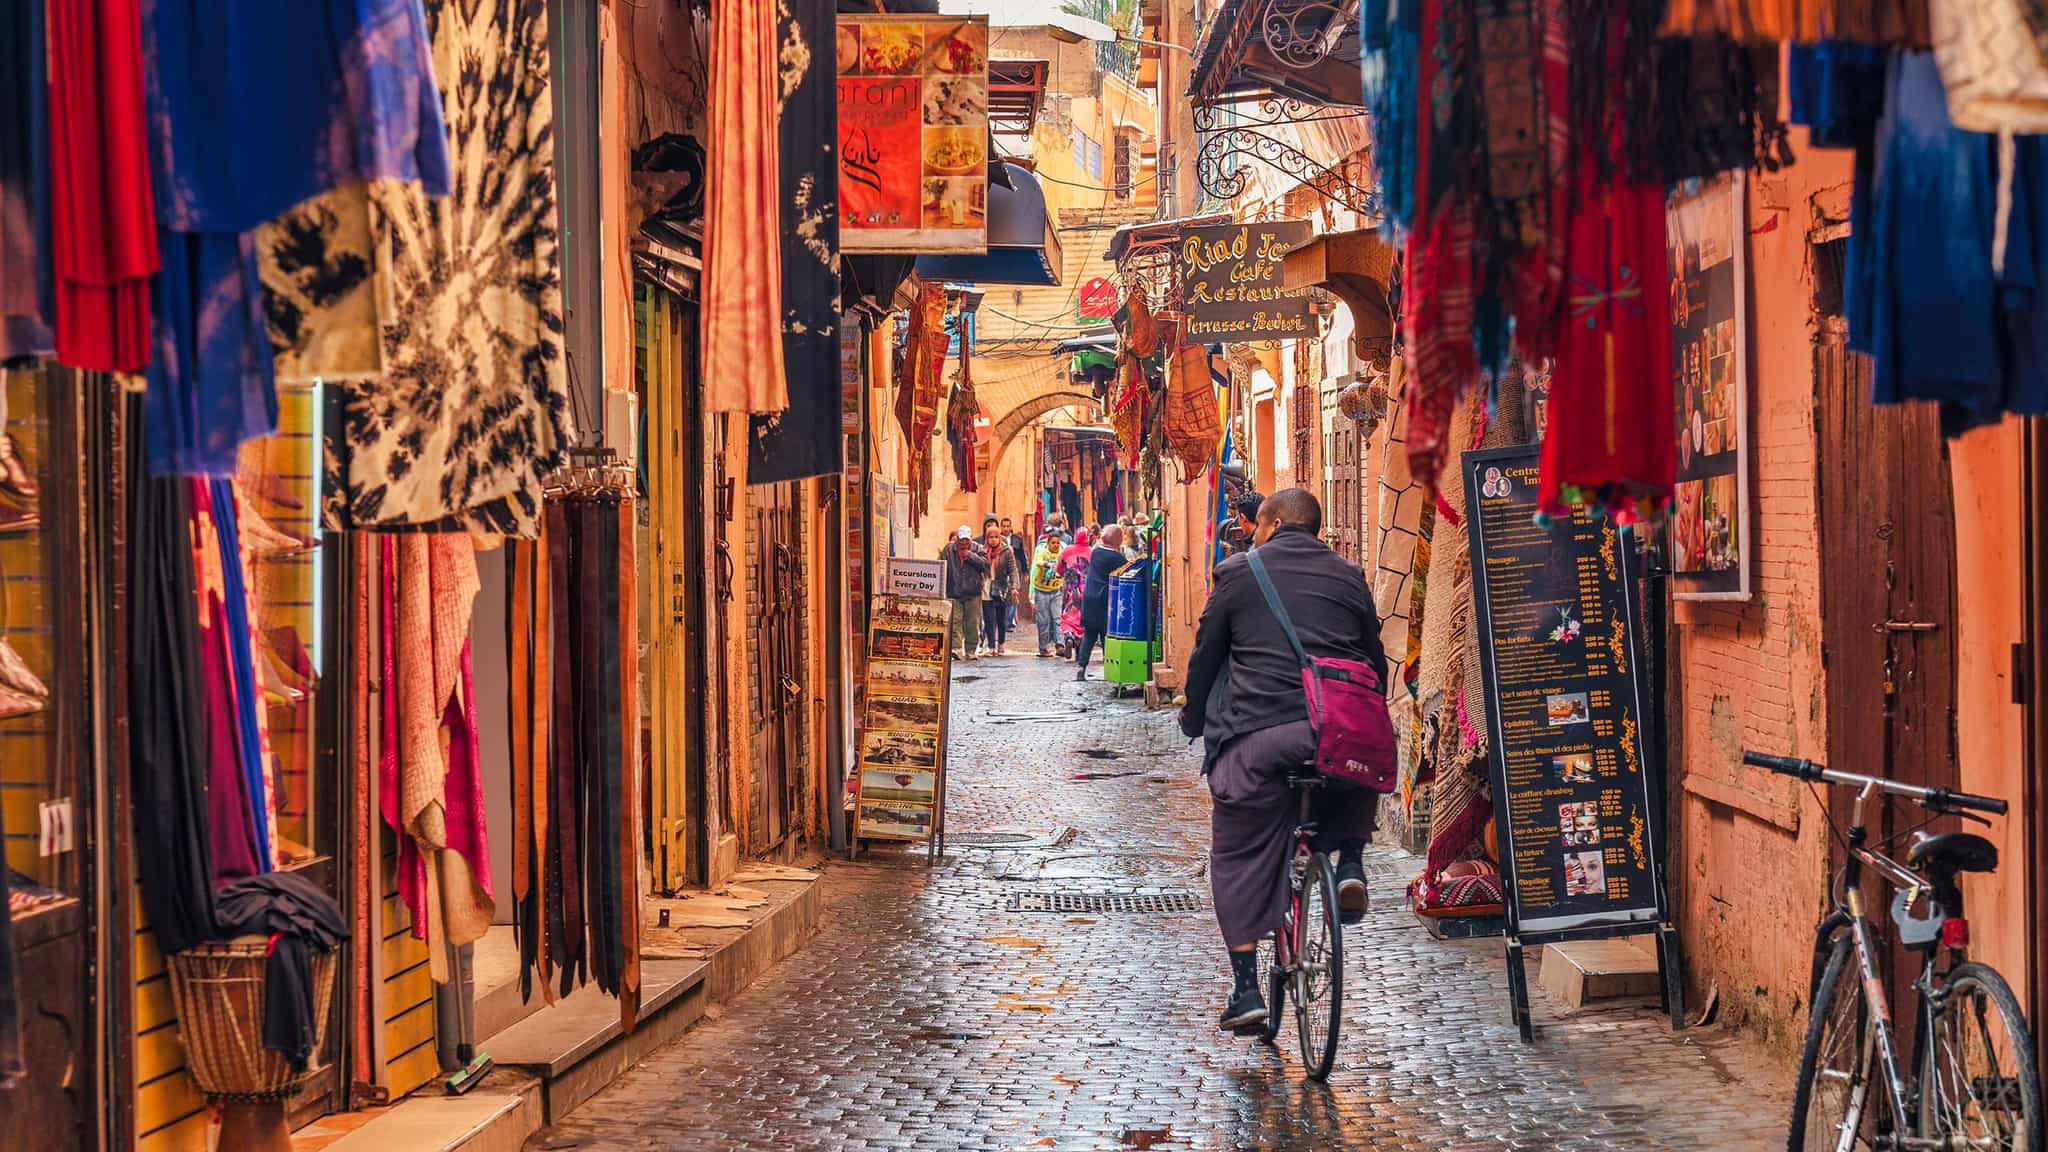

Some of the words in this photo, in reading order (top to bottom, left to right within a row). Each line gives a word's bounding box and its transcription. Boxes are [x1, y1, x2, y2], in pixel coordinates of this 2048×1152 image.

[1183, 226, 1249, 280] Riad
[1231, 259, 1275, 283] Café
[893, 569, 937, 579] Excursions
[895, 580, 917, 590] Every
[919, 582, 935, 591] Day
[890, 624, 912, 632] CHEZ
